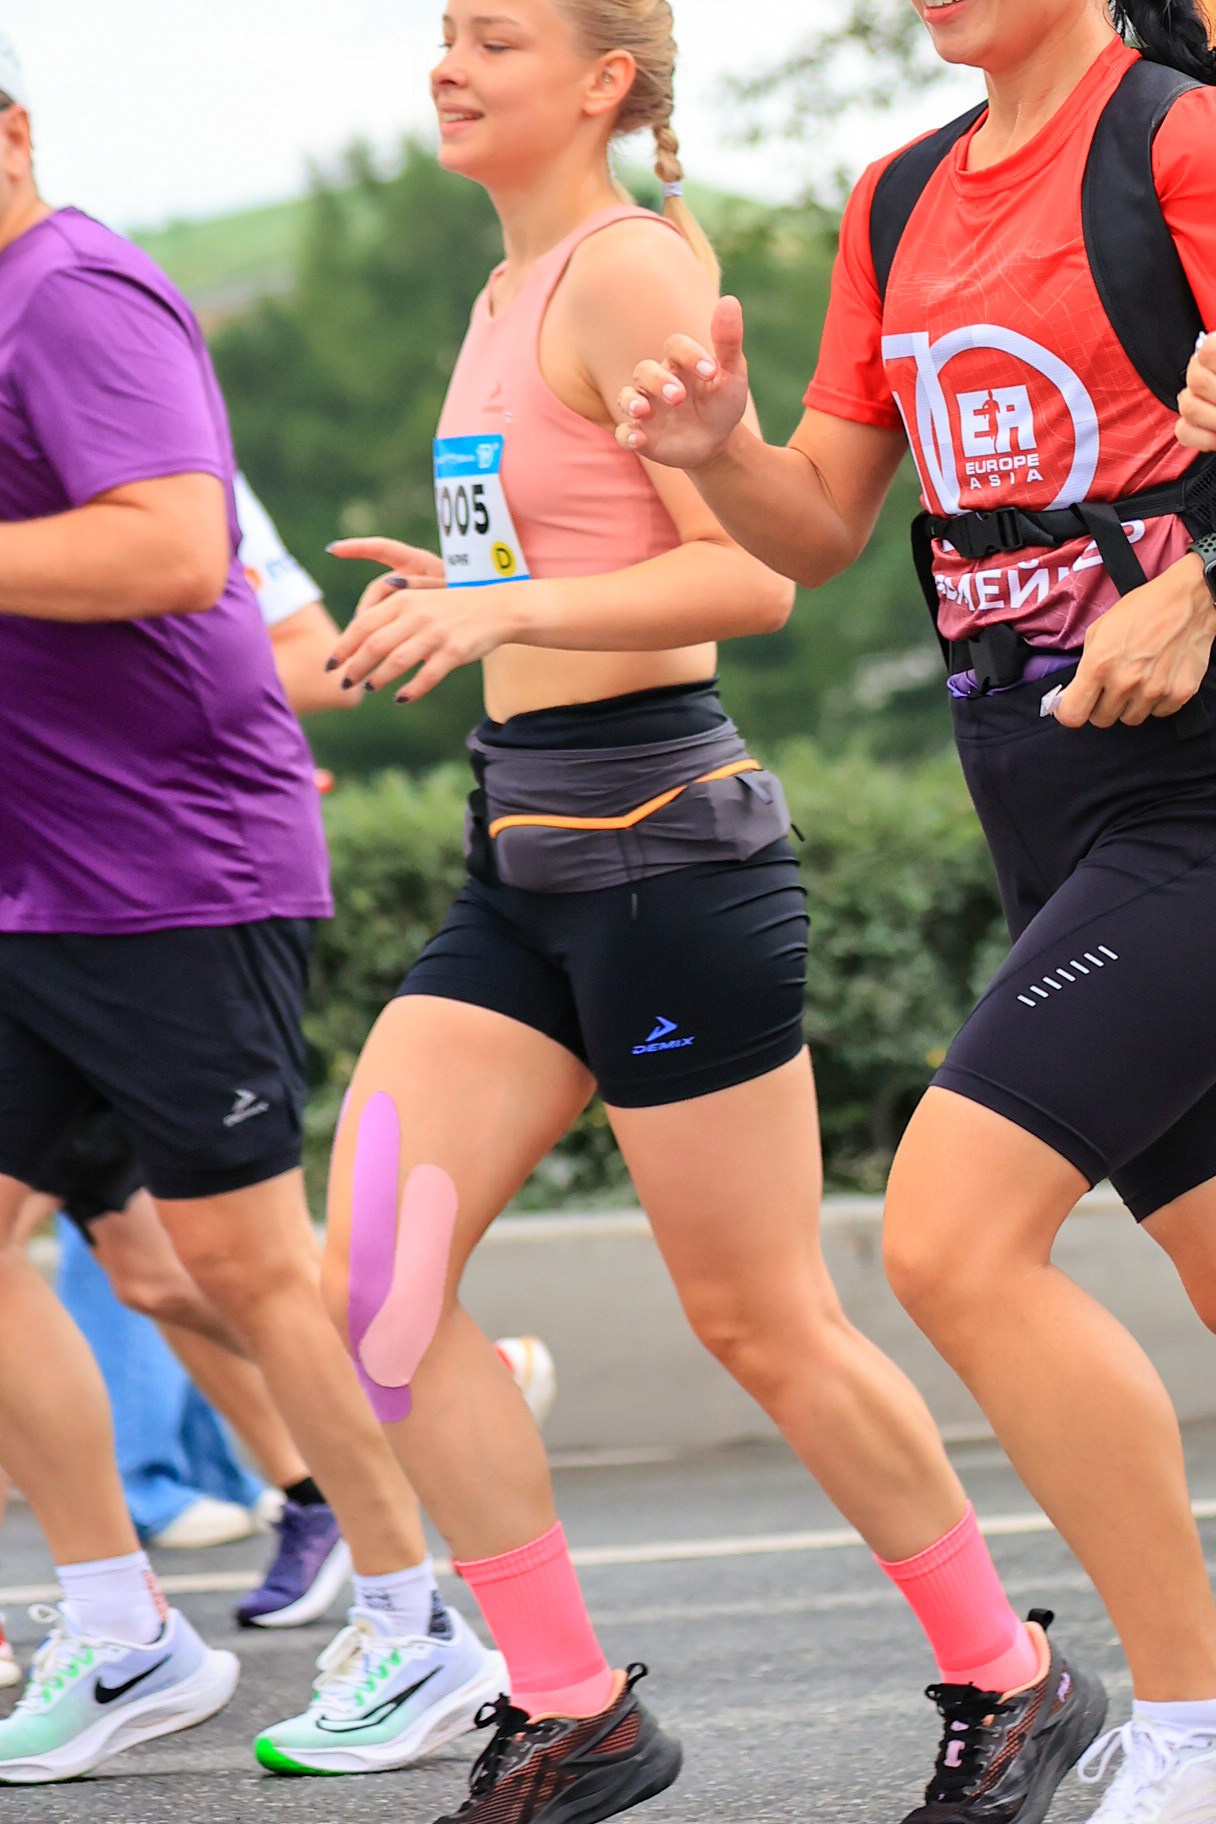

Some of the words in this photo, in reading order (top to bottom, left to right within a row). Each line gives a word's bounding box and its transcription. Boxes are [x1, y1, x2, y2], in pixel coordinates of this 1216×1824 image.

[965, 453, 1040, 476] EUROPE
[969, 468, 1044, 491] ASIA
[631, 1035, 696, 1055] DEMIX
